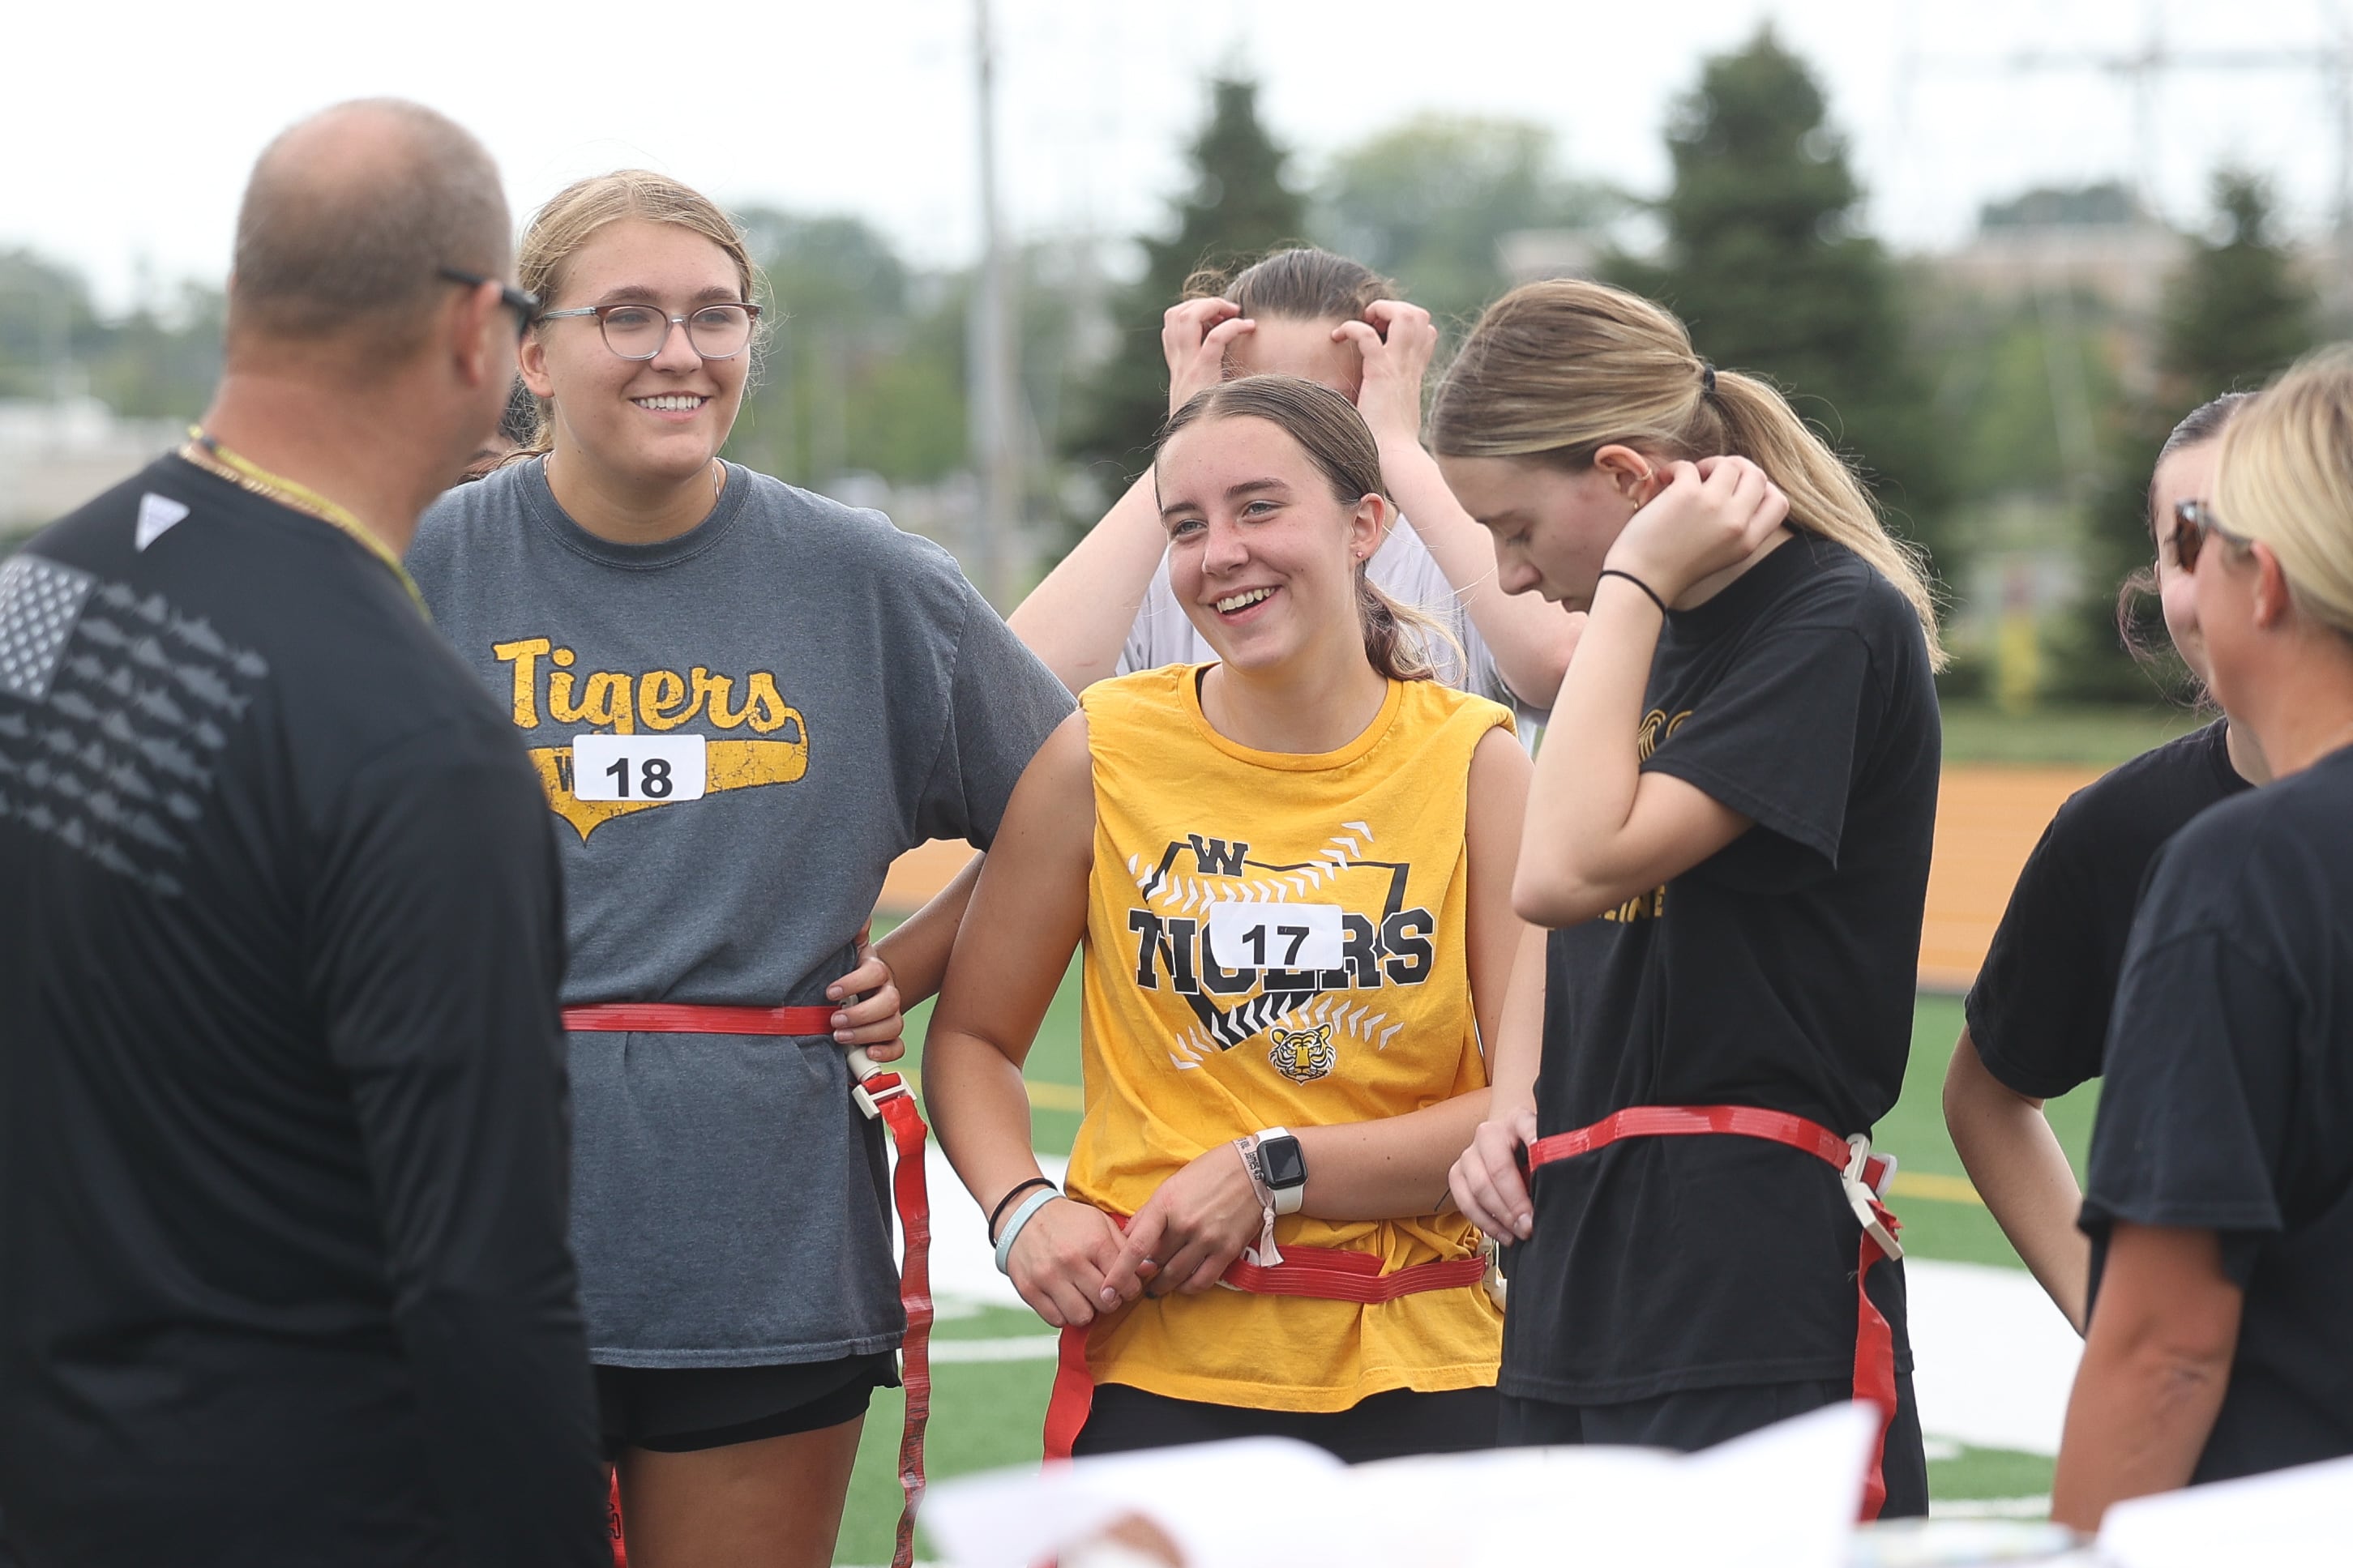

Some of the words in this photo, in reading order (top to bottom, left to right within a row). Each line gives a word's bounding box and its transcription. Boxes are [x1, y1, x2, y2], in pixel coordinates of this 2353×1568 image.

[492, 638, 789, 734] Tigers
[605, 757, 674, 798] 18
[1187, 833, 1249, 877] W
[1242, 924, 1310, 966] 17
